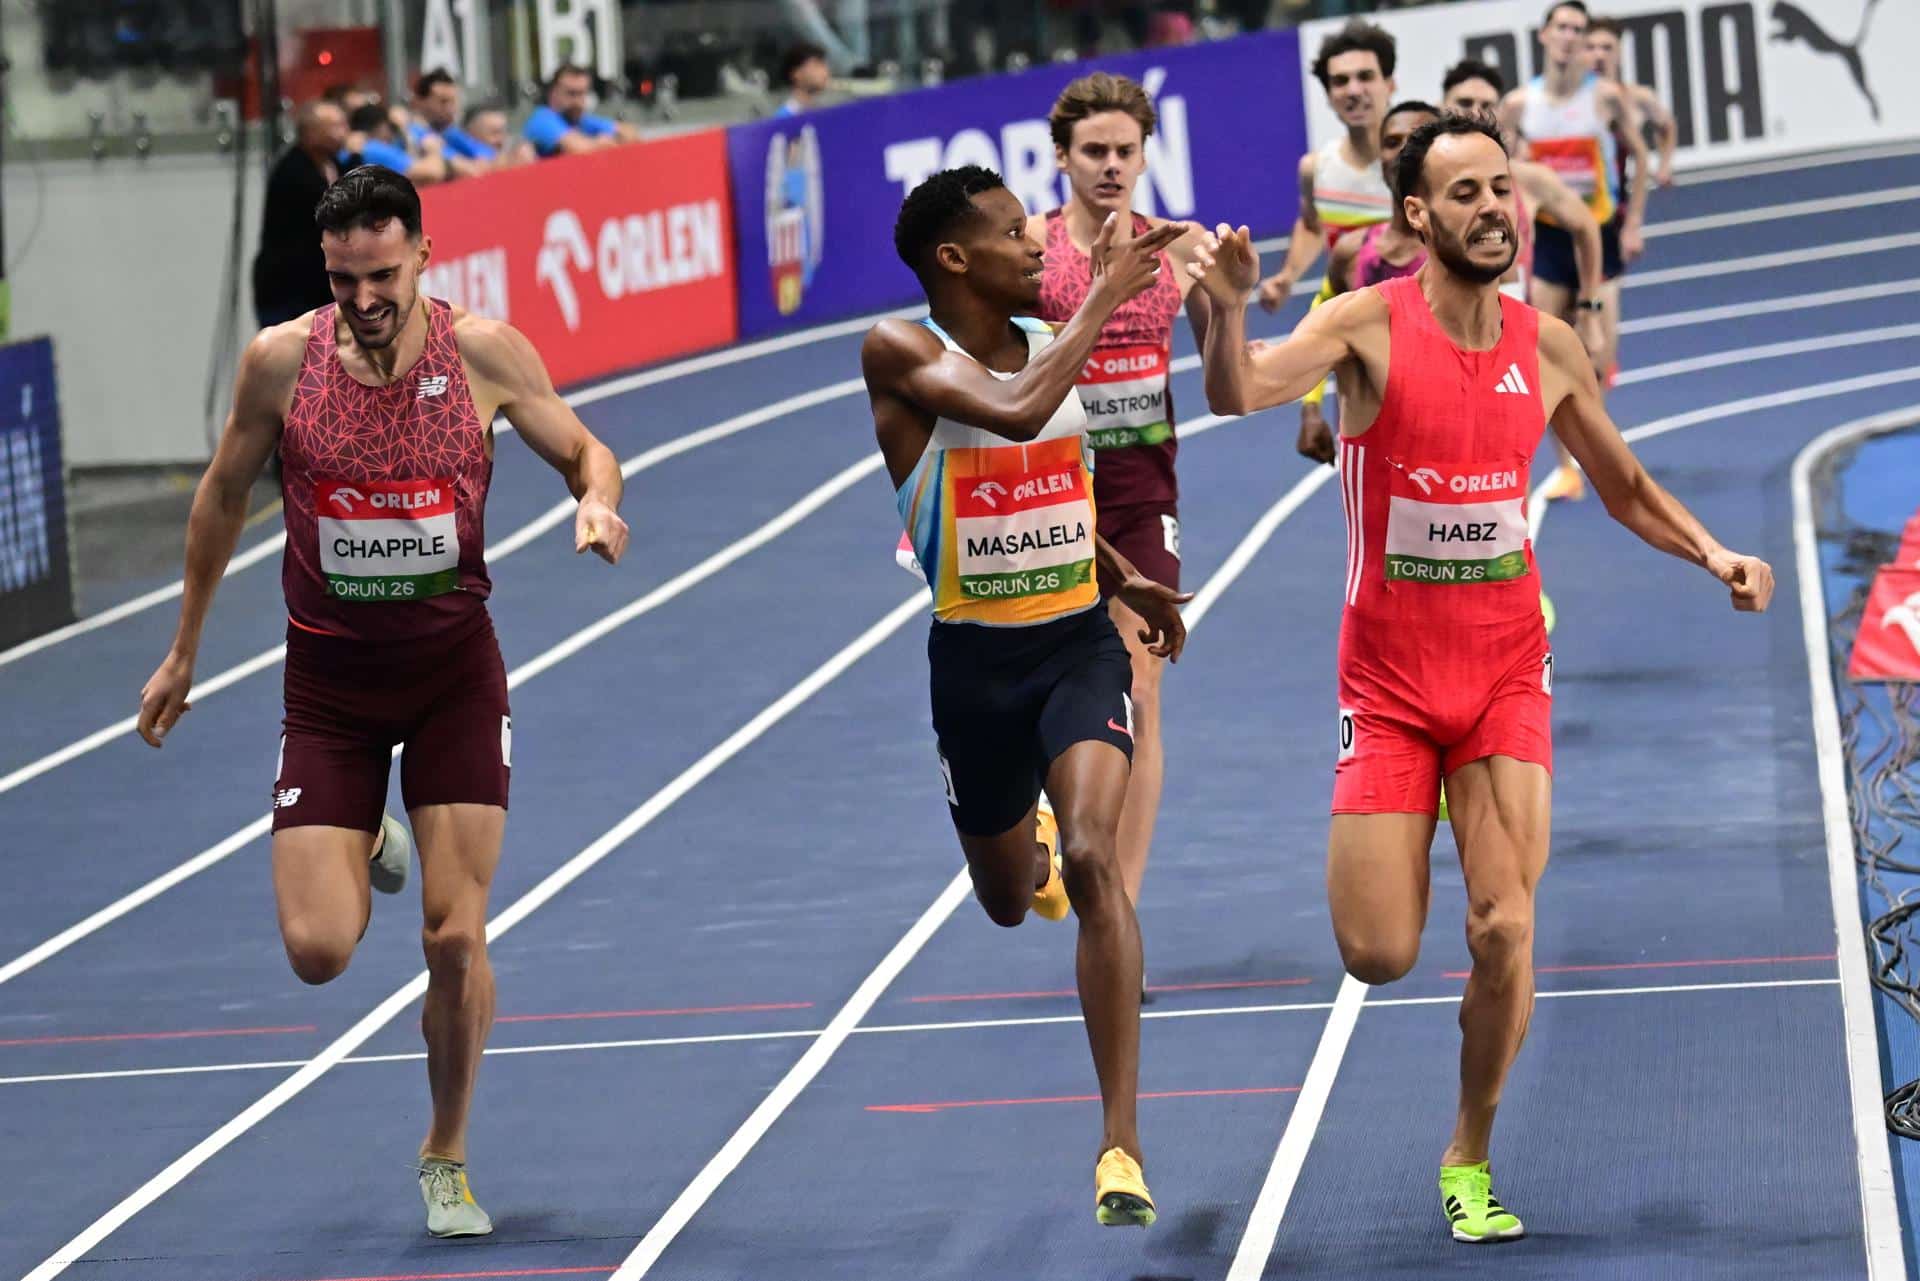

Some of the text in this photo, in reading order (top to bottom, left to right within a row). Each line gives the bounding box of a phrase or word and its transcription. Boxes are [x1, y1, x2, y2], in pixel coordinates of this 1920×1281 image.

[598, 198, 724, 300] ORLEN
[1103, 353, 1159, 375] ORLEN
[1083, 391, 1163, 417] HLSTROM
[1013, 472, 1074, 502] ORLEN
[1450, 470, 1518, 494] ORLEN
[369, 488, 441, 509] ORLEN
[967, 522, 1086, 558] MASALELA
[1428, 522, 1498, 543] HABZ
[333, 535, 446, 559] CHAPPLE
[1390, 560, 1485, 580] TORUŃ 26
[390, 581, 415, 596] 26
[966, 572, 1060, 596] TORUŃ 26
